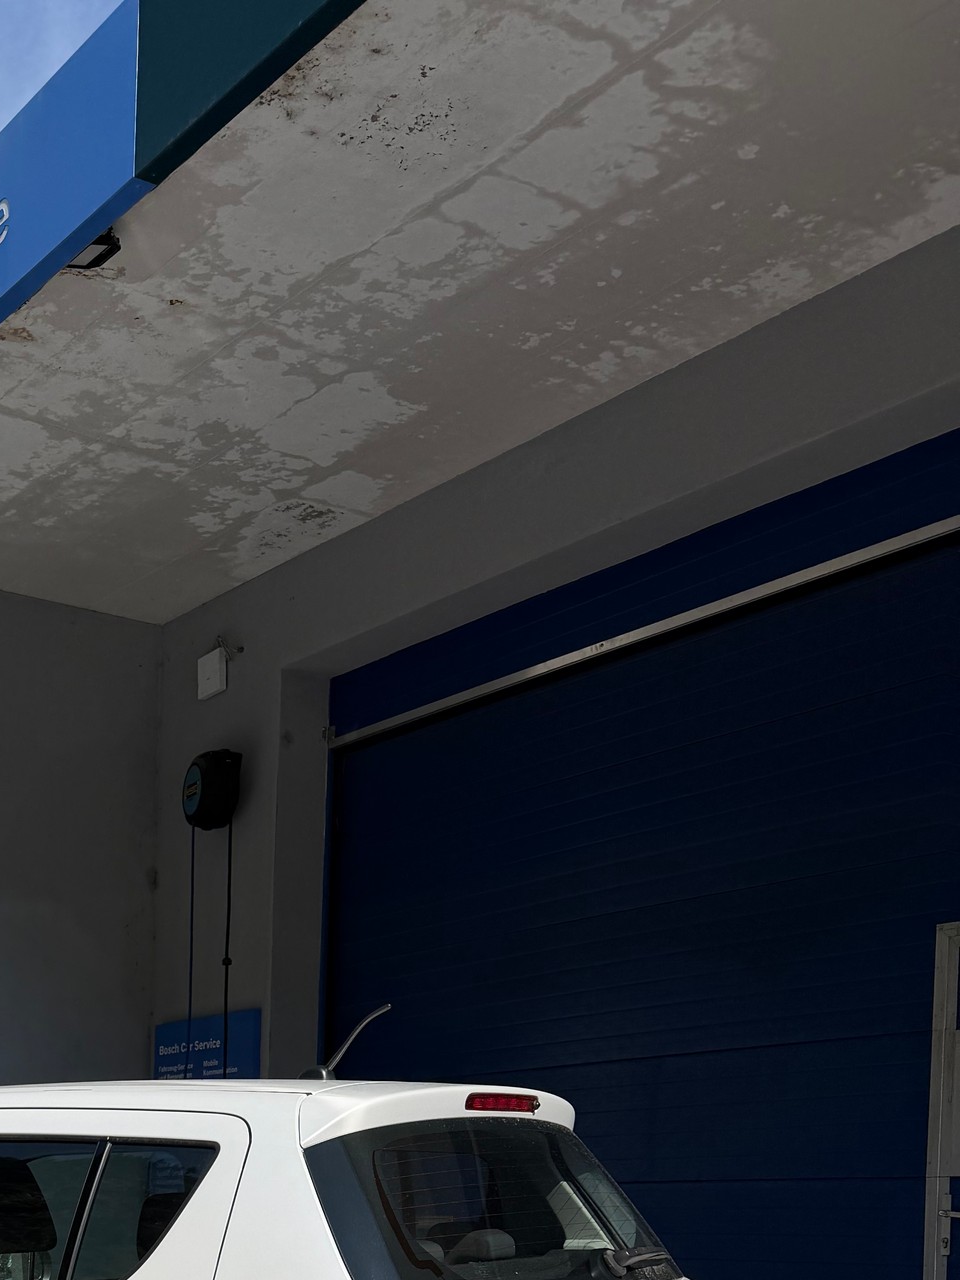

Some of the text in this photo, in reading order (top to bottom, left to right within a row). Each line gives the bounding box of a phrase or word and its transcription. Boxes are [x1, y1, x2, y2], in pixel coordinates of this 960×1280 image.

[159, 1038, 221, 1056] Bosch Cr Service
[203, 1067, 238, 1075] Kommuniation
